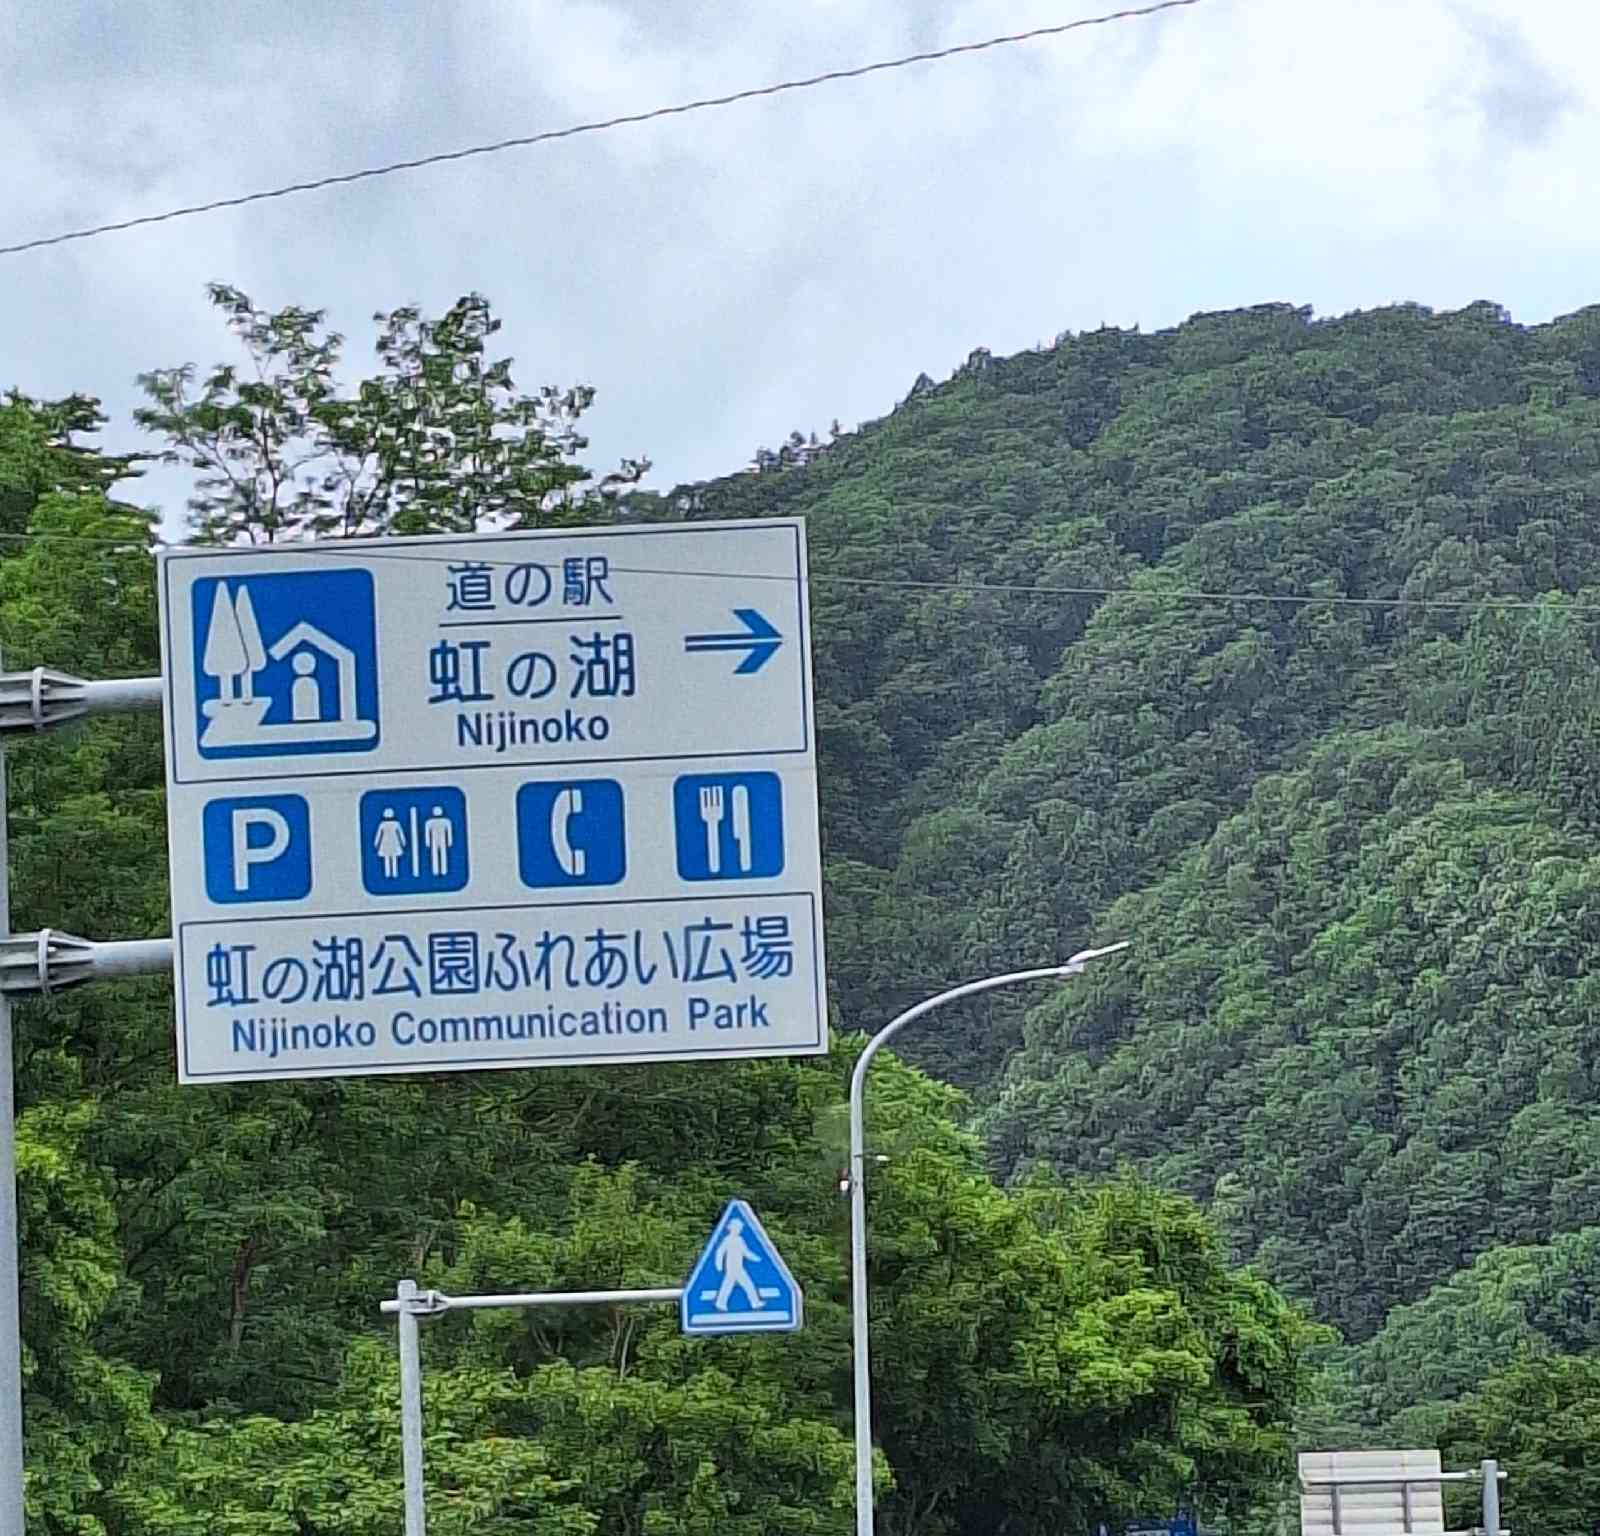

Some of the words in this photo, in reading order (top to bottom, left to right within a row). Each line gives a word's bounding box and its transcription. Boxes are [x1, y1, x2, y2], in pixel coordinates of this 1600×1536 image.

[446, 557, 612, 611] 道の駅
[428, 632, 636, 703] 虹の湖
[458, 709, 608, 752] Nijinoko
[233, 807, 290, 891] P
[206, 916, 793, 1007] 虹の湖公園ふれあい広場
[232, 1015, 376, 1057] Nijinoko
[391, 1003, 667, 1045] Communication
[688, 996, 769, 1031] Park
